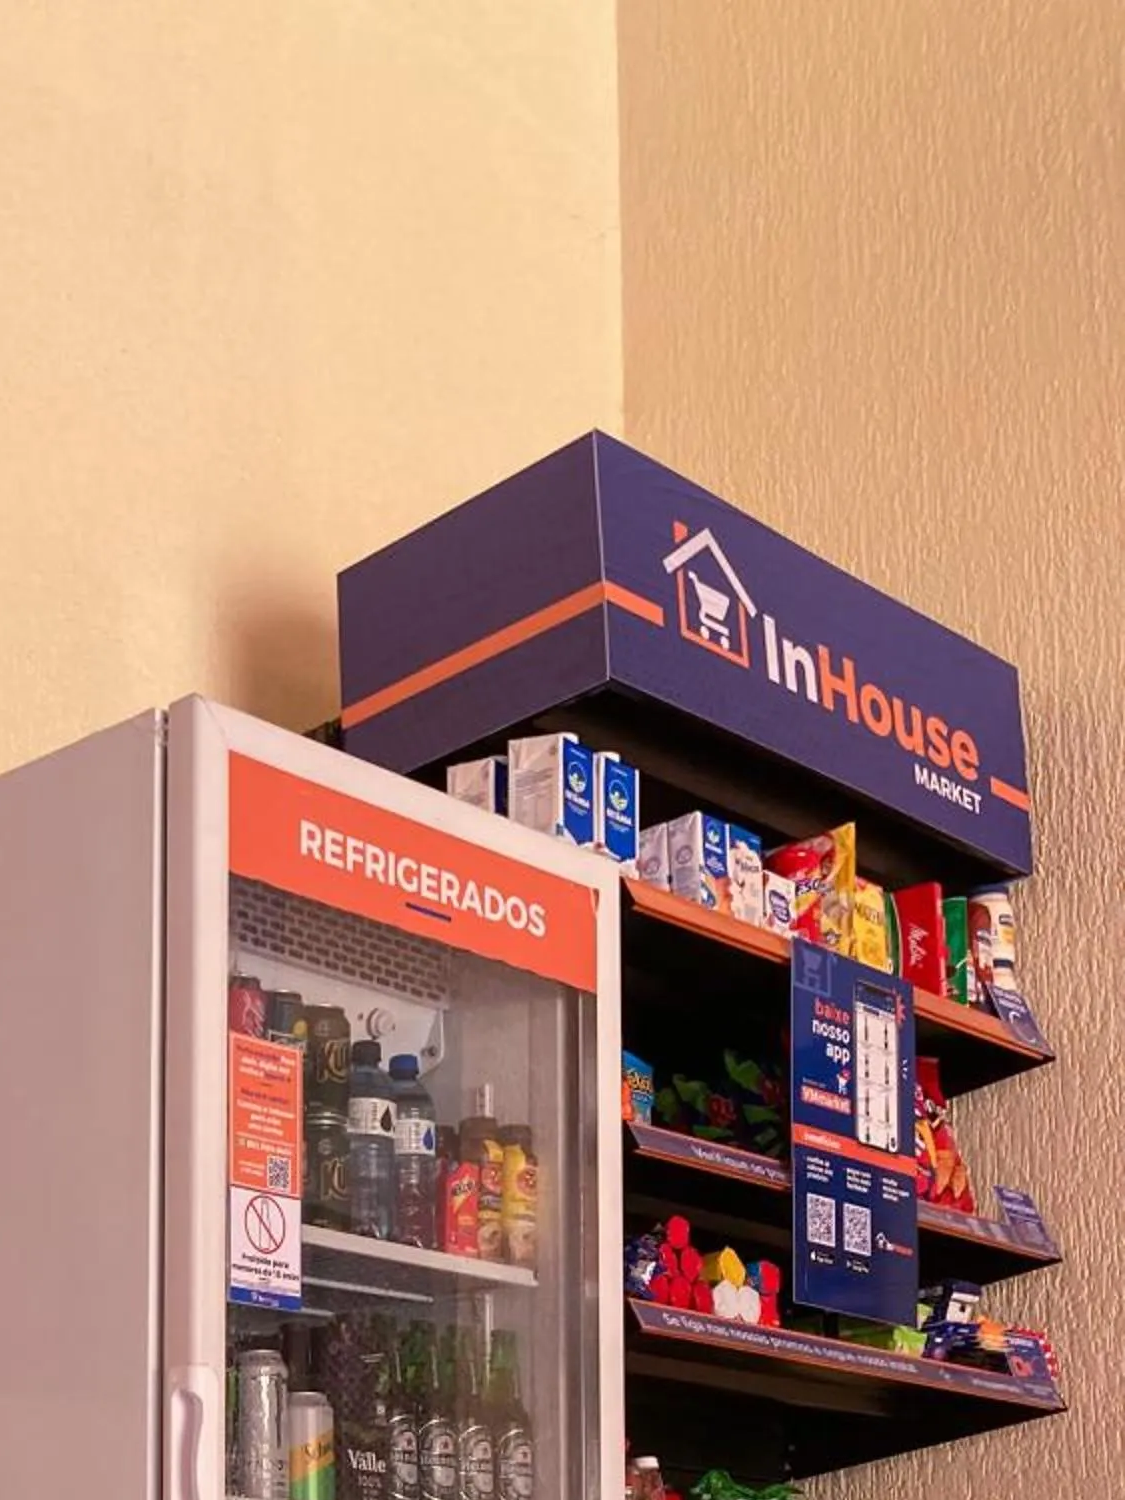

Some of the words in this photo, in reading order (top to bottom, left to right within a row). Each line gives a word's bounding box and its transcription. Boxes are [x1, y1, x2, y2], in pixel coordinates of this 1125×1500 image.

[763, 612, 980, 781] InHouse
[914, 763, 982, 814] MARKET
[299, 819, 548, 938] REFRIGERADOS
[812, 1019, 851, 1044] nosso
[826, 1042, 851, 1065] app
